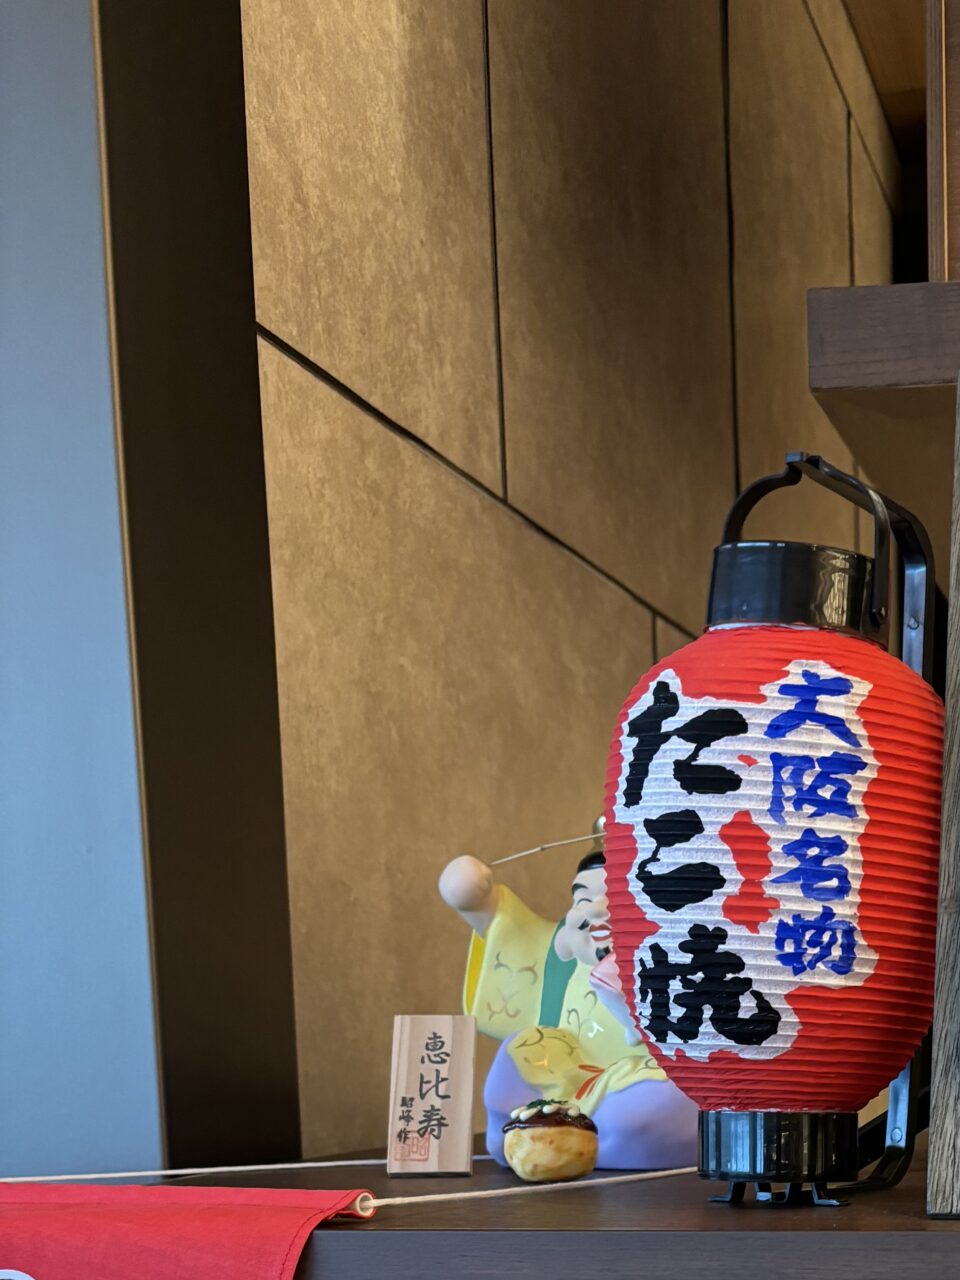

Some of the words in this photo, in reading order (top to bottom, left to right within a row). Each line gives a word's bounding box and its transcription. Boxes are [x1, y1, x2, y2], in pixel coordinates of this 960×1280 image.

[764, 669, 868, 977] 大阪名物
[417, 1032, 452, 1140] 恵比寿
